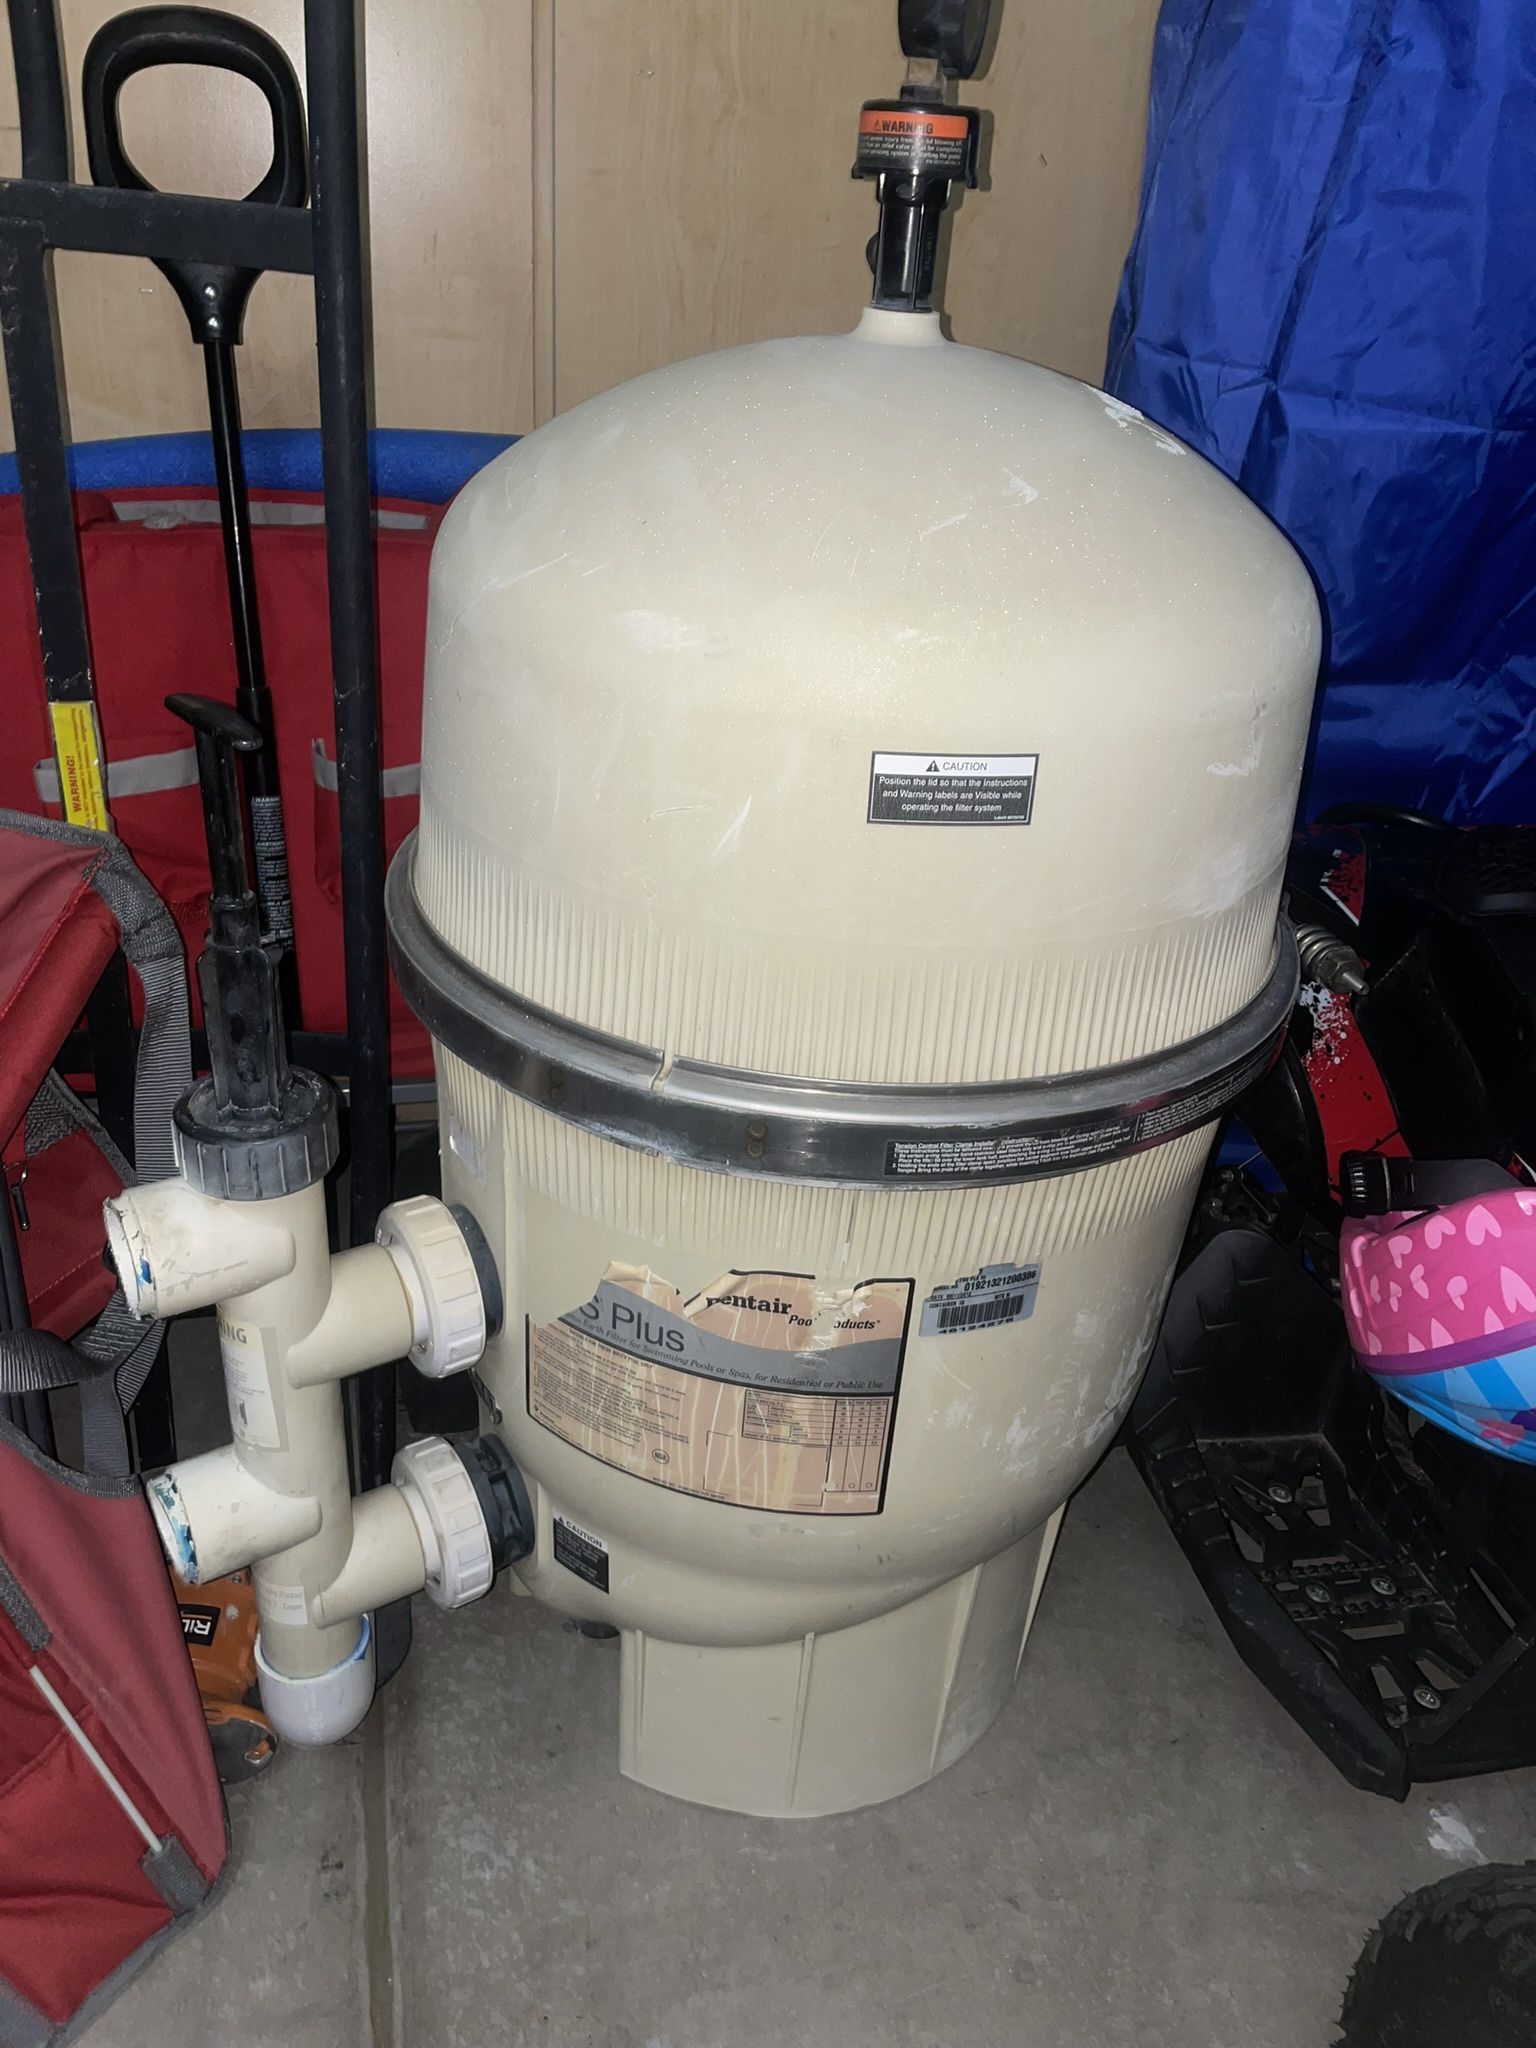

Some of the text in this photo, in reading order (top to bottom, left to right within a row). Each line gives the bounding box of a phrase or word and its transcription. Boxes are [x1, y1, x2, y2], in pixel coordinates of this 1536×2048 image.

[882, 120, 933, 134] WARNG
[942, 762, 988, 771] CAUTION
[65, 755, 82, 813] WARNING!
[879, 776, 911, 785] Position
[913, 777, 926, 785] the
[928, 778, 938, 786] lid
[951, 779, 967, 787] that
[968, 779, 982, 787] the
[882, 790, 898, 798] and
[900, 789, 933, 800] Warning
[934, 791, 958, 799] labels
[975, 791, 1000, 799] Visible
[1002, 791, 1022, 799] while
[901, 803, 939, 813] operating
[974, 804, 1002, 813] system
[789, 1314, 815, 1327] Poo
[611, 1302, 685, 1353] Plus
[583, 1319, 604, 1335] Earth
[606, 1327, 627, 1345] Filter
[629, 1339, 641, 1350] for
[642, 1344, 689, 1367] Swimming
[690, 1359, 714, 1372] Pools
[755, 1372, 768, 1383] for
[771, 1375, 822, 1388] Residential
[824, 1381, 834, 1389] or
[835, 1380, 865, 1390] Public
[868, 1380, 885, 1389] Use
[565, 1520, 602, 1548] CAUTION
